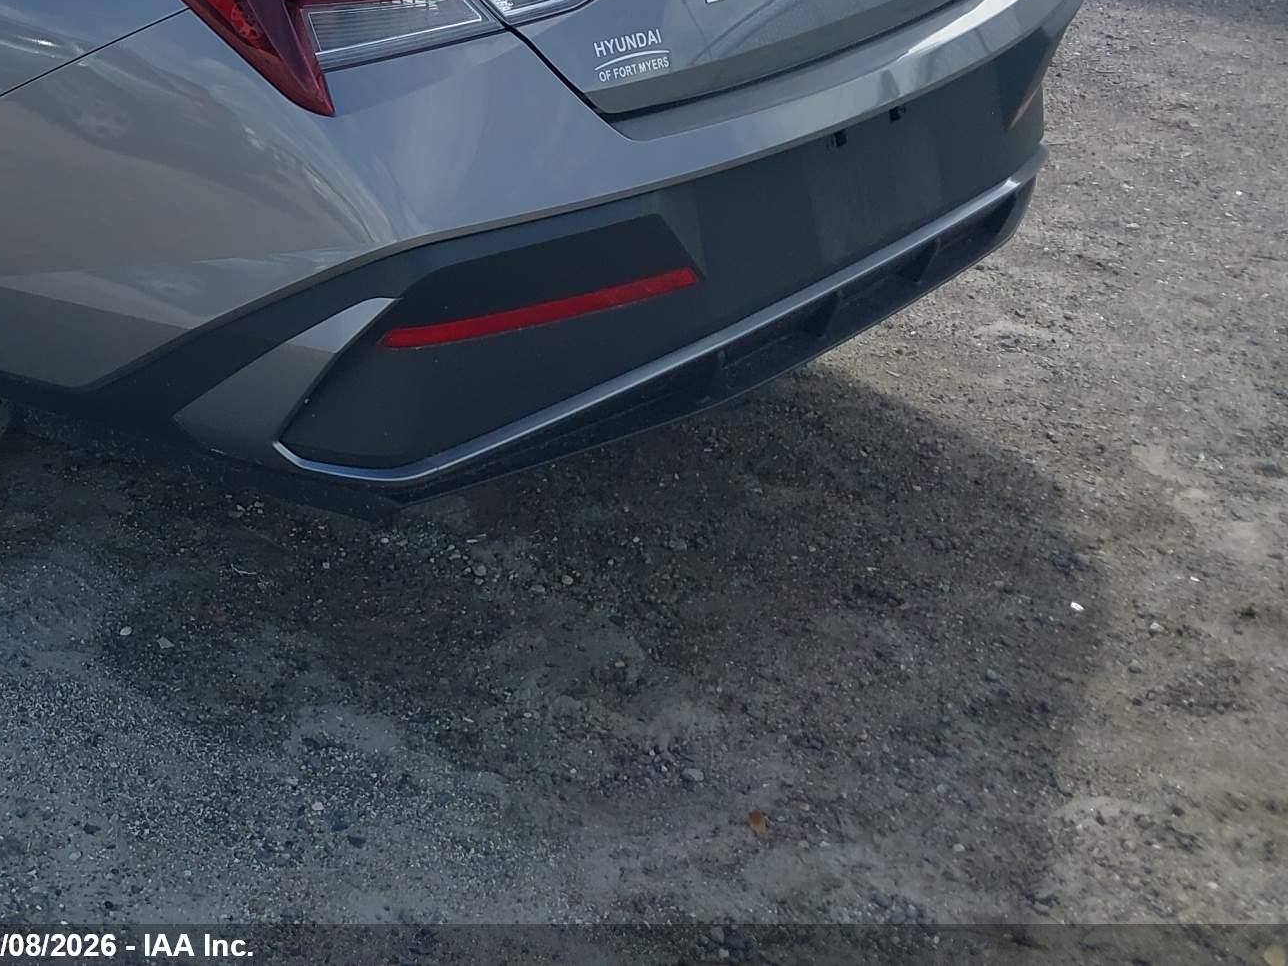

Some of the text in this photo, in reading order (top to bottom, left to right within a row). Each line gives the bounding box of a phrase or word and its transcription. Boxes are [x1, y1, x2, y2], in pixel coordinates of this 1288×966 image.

[593, 28, 662, 58] HYUNDAI
[598, 56, 670, 83] OF FORT MYERS
